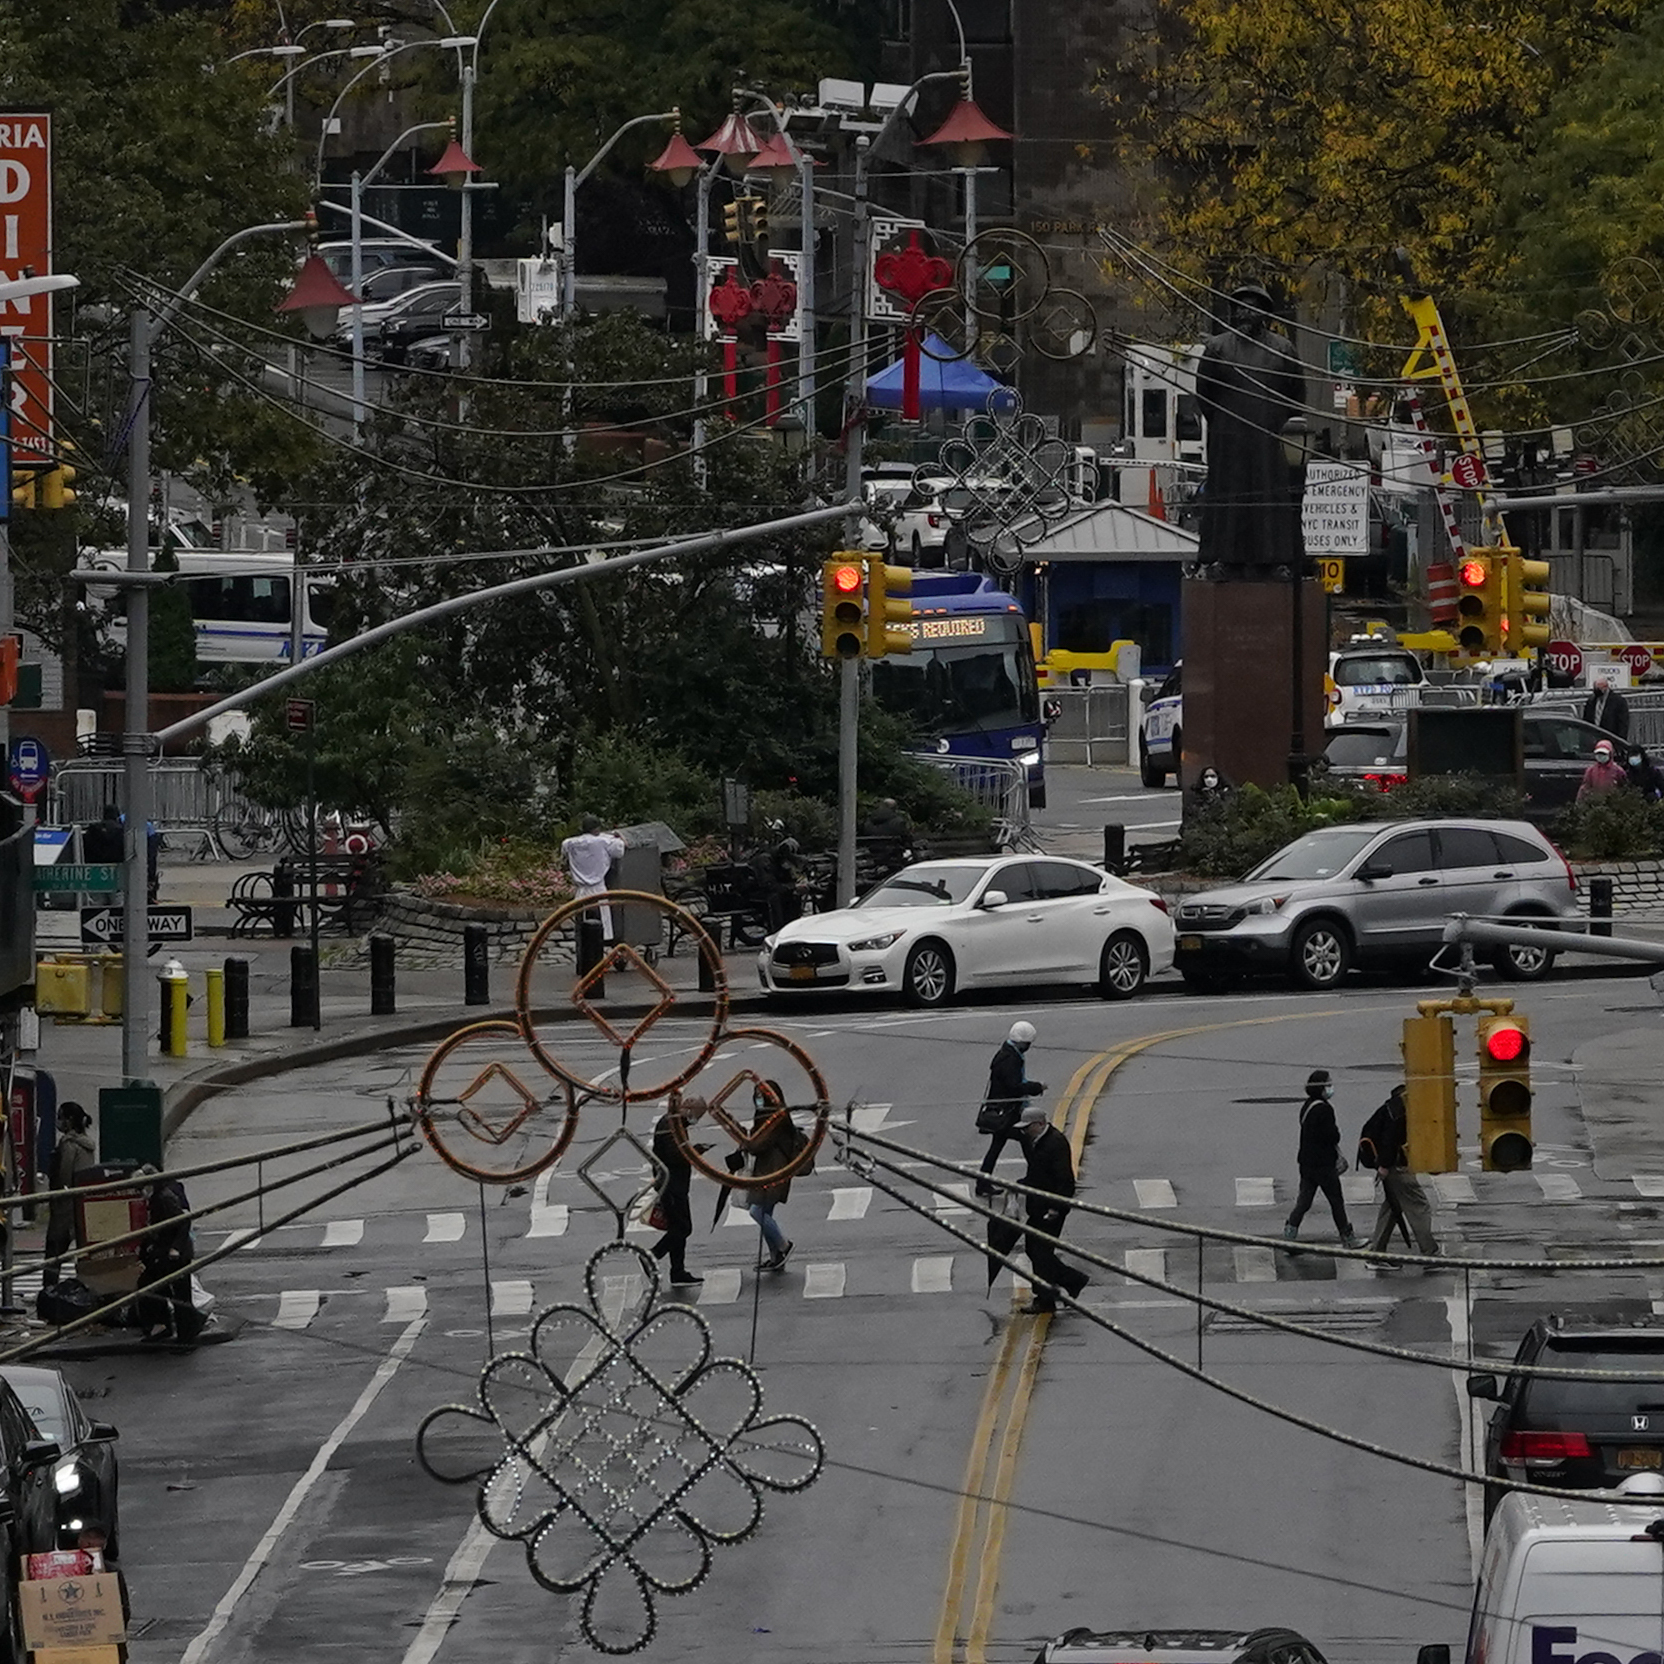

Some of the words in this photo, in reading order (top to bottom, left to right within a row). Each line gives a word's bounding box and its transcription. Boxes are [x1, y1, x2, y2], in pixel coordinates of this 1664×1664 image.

[1458, 454, 1479, 489] STOP
[1311, 485, 1367, 498] EMERGENCY
[1303, 503, 1347, 515] VEHICLES
[1321, 519, 1360, 531] TRANSIT
[1334, 536, 1358, 547] ONLY
[922, 618, 985, 638] REQUIRED
[1549, 653, 1581, 672] TOP
[1621, 653, 1651, 668] STOP
[35, 866, 91, 881] ATHERINE
[95, 917, 124, 933] ONE
[148, 914, 183, 932] WAY
